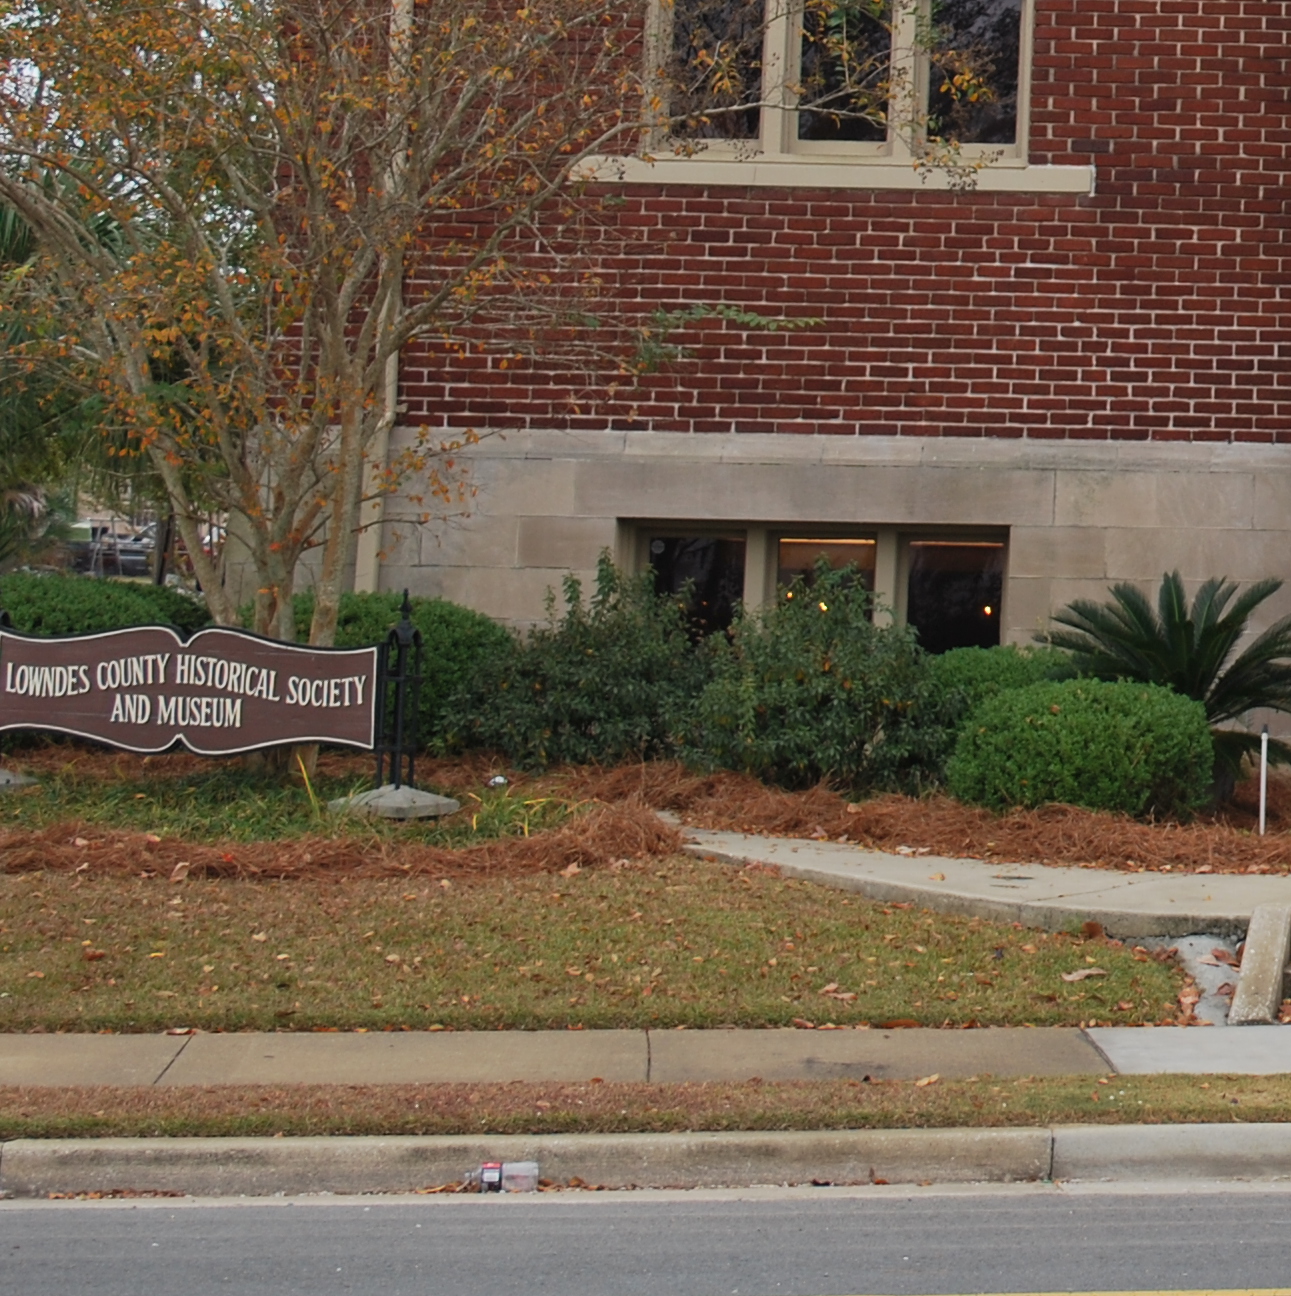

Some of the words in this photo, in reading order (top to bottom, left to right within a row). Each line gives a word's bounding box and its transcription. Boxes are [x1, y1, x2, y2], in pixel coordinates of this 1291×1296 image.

[6, 662, 91, 697] LOWNDES
[97, 653, 171, 690] COUNTY
[176, 654, 280, 701] HISTORICAL
[286, 675, 366, 707] SOCIETY
[110, 693, 151, 724] AND
[157, 695, 242, 728] MUSEUM
